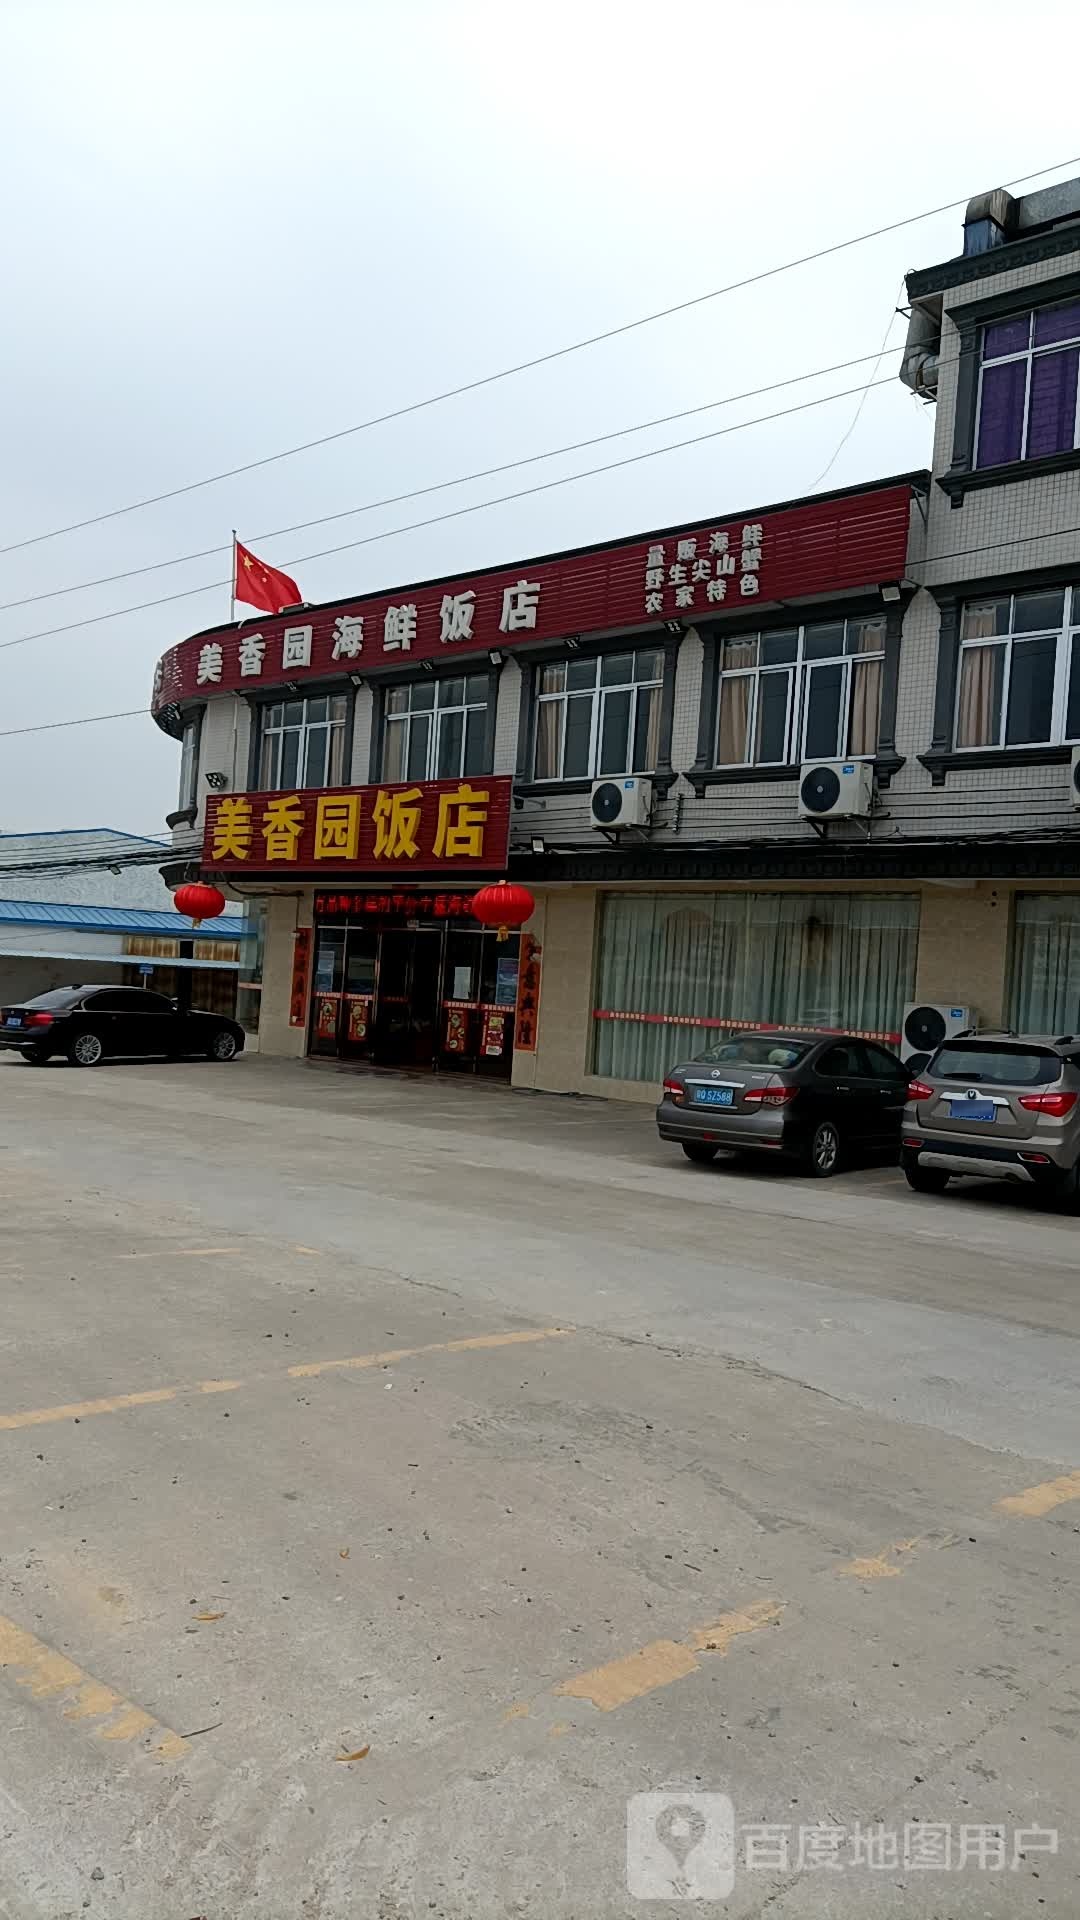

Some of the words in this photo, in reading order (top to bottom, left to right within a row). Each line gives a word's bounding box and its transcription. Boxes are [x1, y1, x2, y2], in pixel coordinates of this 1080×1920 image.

[196, 579, 541, 686] 美香园海鲜饭店
[644, 574, 759, 614] 农家特色
[211, 783, 490, 862] 美香园饭店
